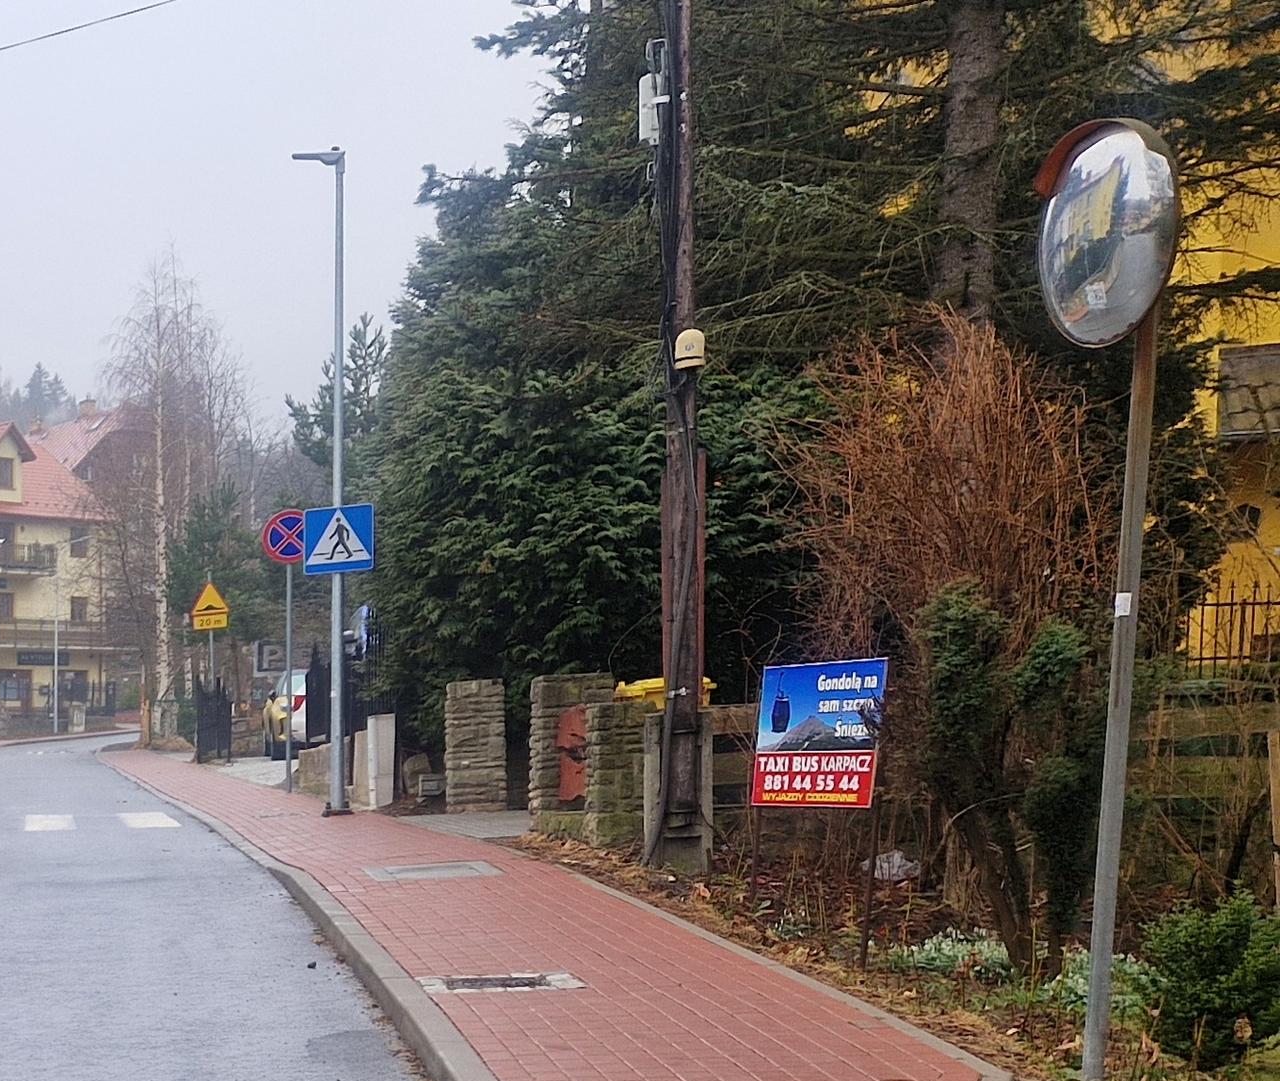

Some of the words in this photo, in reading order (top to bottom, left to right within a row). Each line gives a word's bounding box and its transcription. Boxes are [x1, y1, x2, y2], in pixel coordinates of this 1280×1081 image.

[199, 618, 212, 627] 20
[213, 618, 223, 626] m
[817, 671, 862, 693] Gondolą
[864, 675, 878, 689] na
[818, 699, 840, 713] sam
[758, 756, 790, 772] TAXI
[792, 755, 819, 772] BUS
[820, 755, 872, 772] KARPACZ
[763, 774, 790, 791] 881
[792, 774, 812, 791] 44
[815, 774, 835, 791] 55
[838, 774, 860, 791] 44
[762, 792, 804, 802] WYJAZDY
[805, 793, 859, 803] CODZIENNIE
